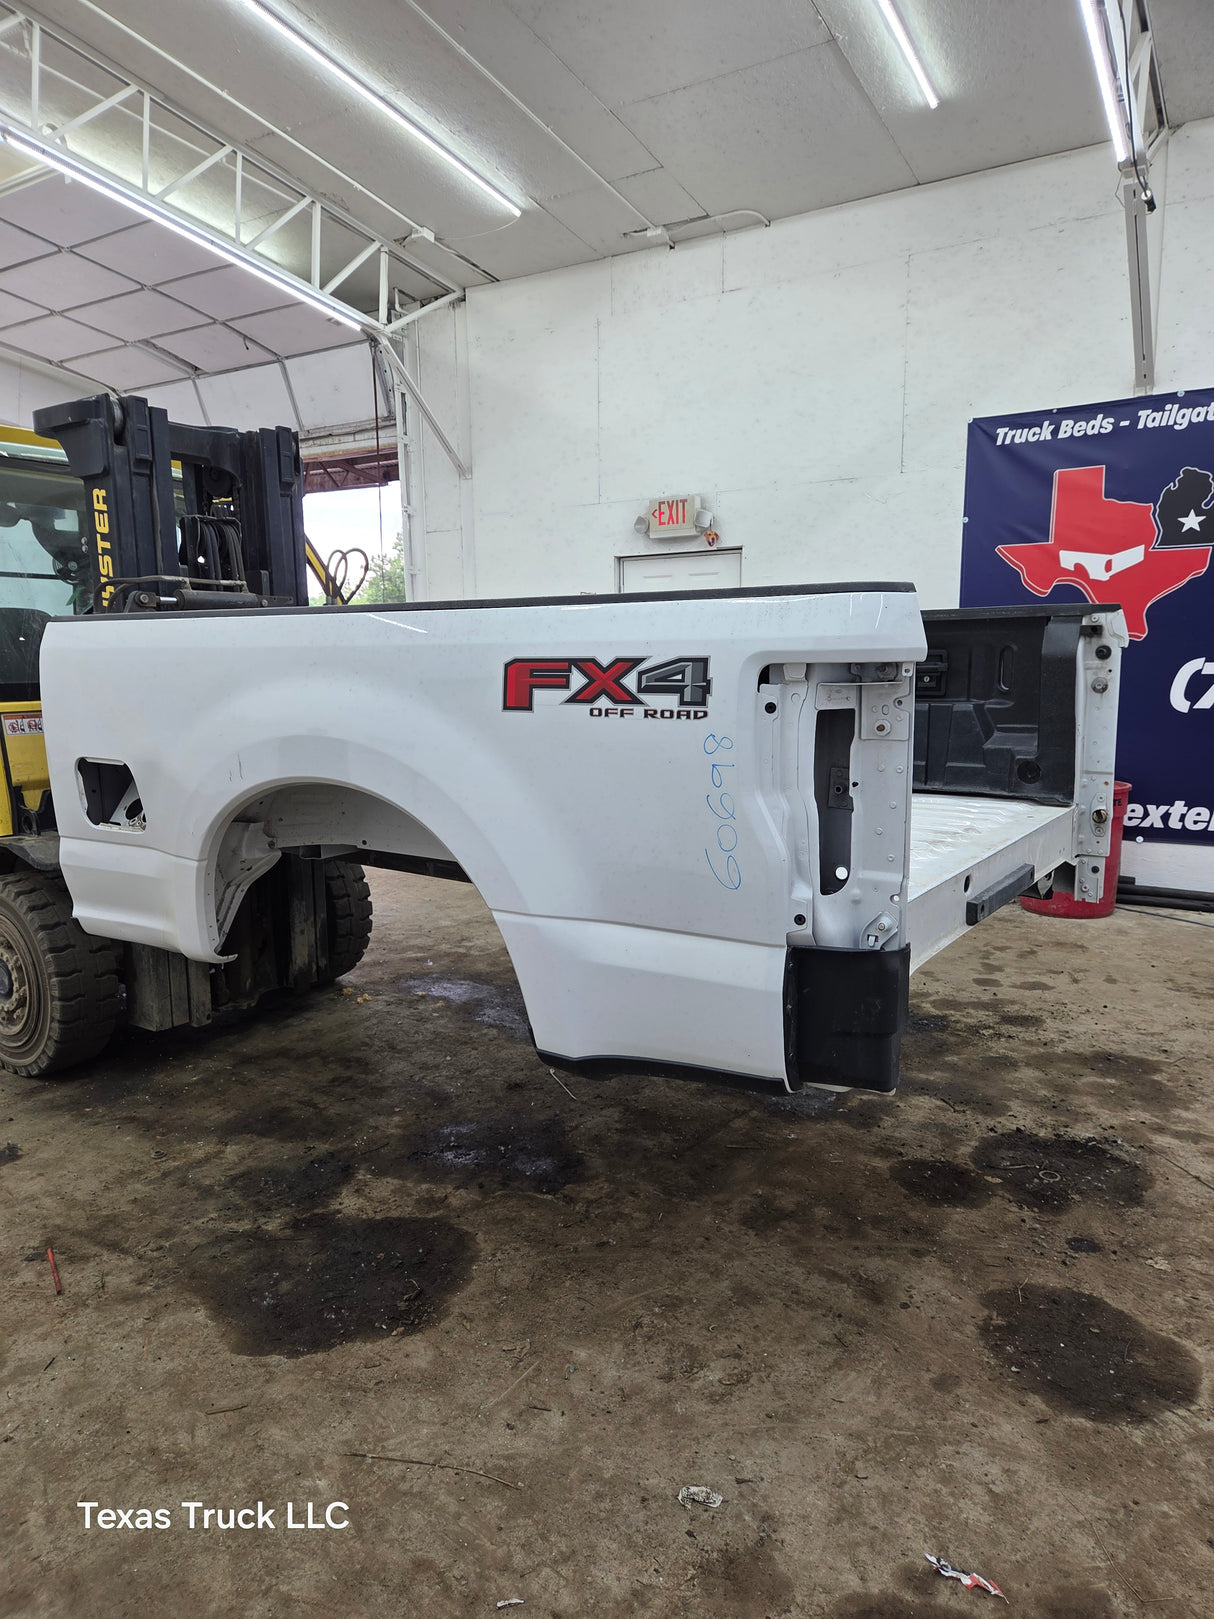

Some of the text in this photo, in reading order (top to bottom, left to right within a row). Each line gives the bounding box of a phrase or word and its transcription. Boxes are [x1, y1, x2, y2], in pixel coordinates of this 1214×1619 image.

[996, 421, 1055, 446] Truck
[1057, 413, 1115, 439] Beds
[658, 498, 688, 526] EXIT
[502, 656, 713, 713] FX4
[589, 707, 709, 720] OFF ROAD
[704, 733, 742, 890] 60698
[1123, 801, 1214, 831] exte
